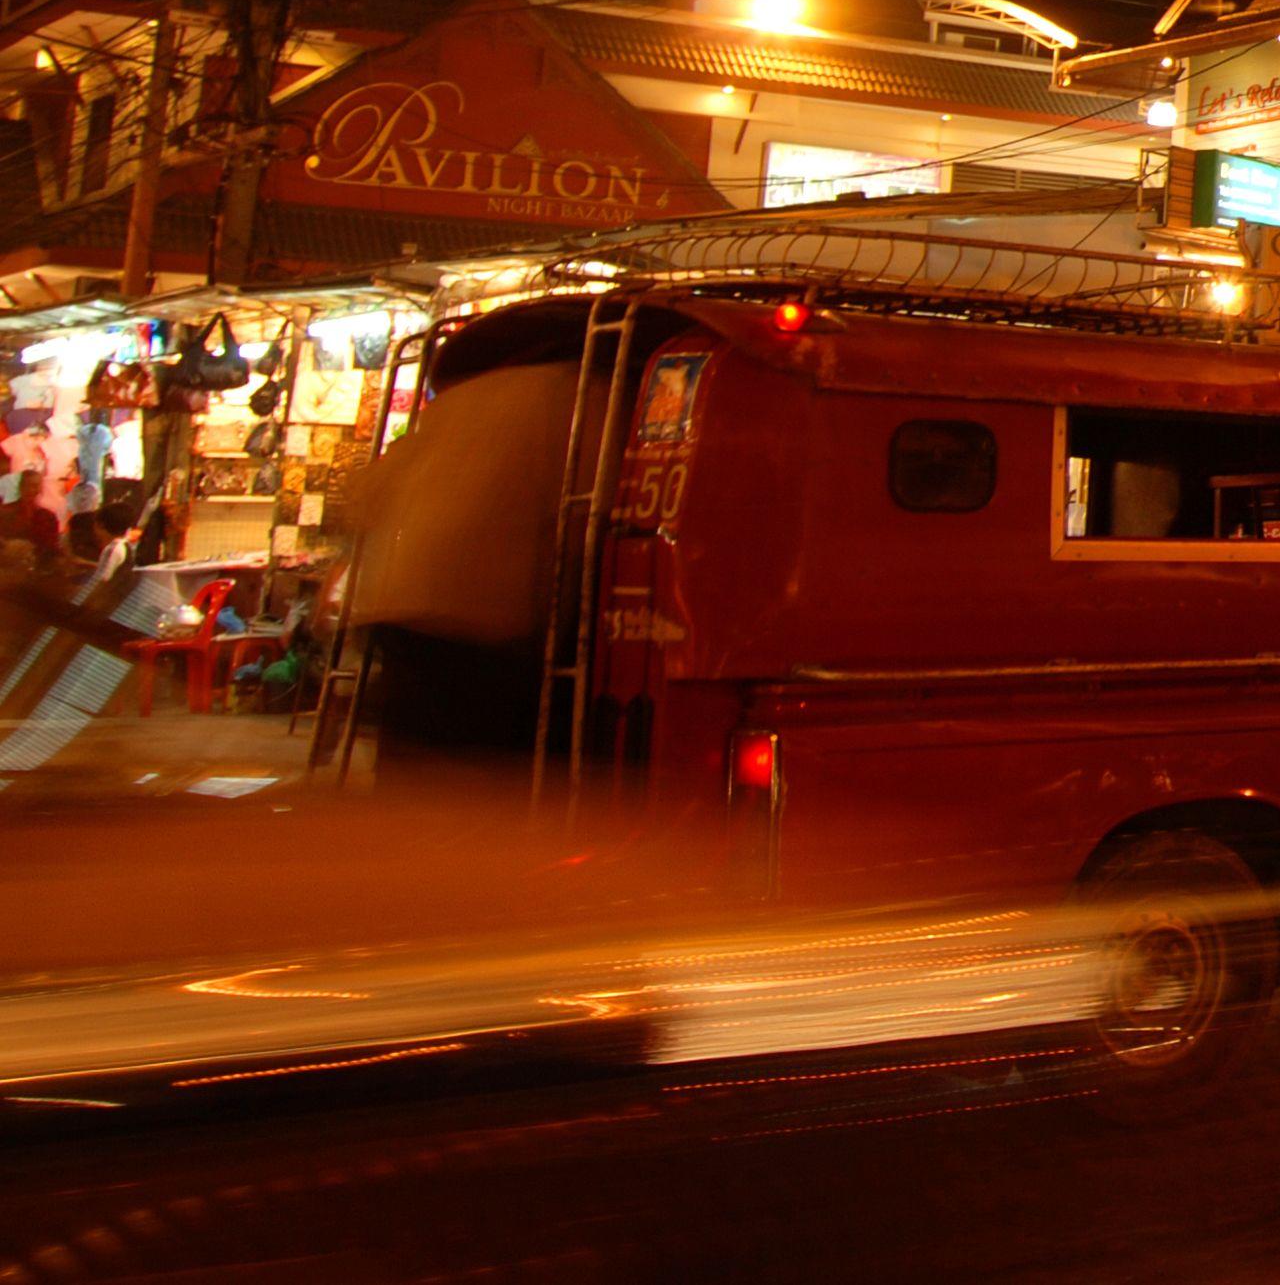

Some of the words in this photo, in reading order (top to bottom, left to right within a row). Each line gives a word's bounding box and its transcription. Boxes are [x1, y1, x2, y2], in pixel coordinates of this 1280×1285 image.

[305, 81, 648, 206] PAVILION
[488, 197, 553, 216] NIGHT
[561, 201, 635, 224] BAZAAR
